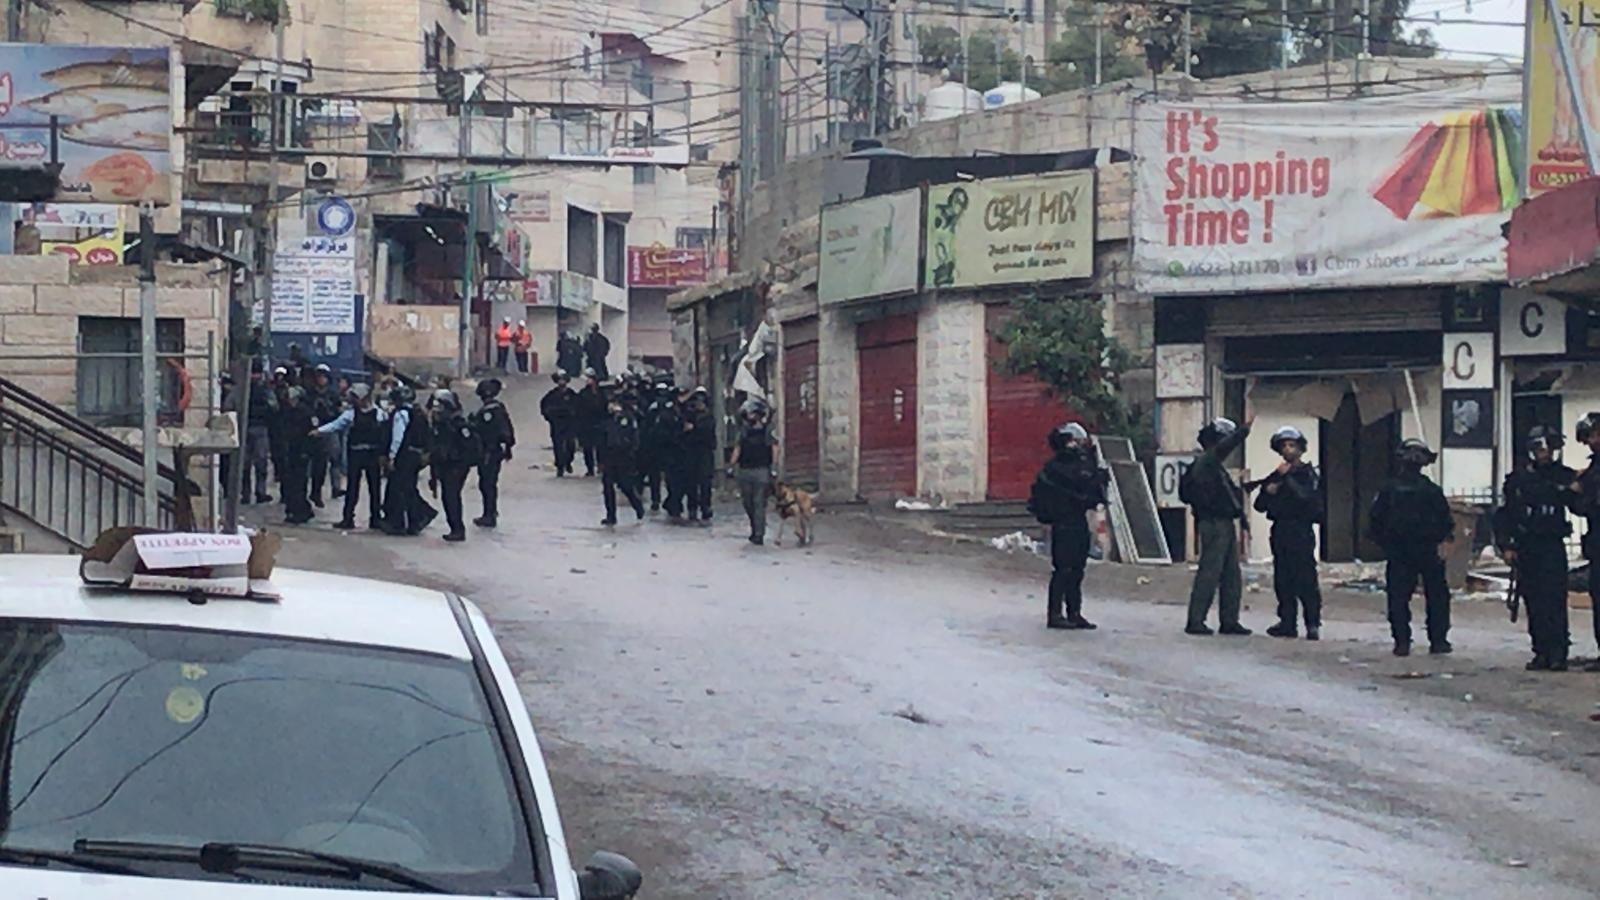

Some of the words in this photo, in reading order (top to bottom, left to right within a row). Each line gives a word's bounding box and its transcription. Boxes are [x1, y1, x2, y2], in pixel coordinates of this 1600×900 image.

[1165, 110, 1219, 153] It's
[1165, 150, 1331, 202] Shopping
[1038, 185, 1079, 226] MIX
[1163, 202, 1251, 247] Time
[1365, 251, 1409, 270] shoes
[1519, 301, 1545, 339] C
[1452, 341, 1475, 380] C
